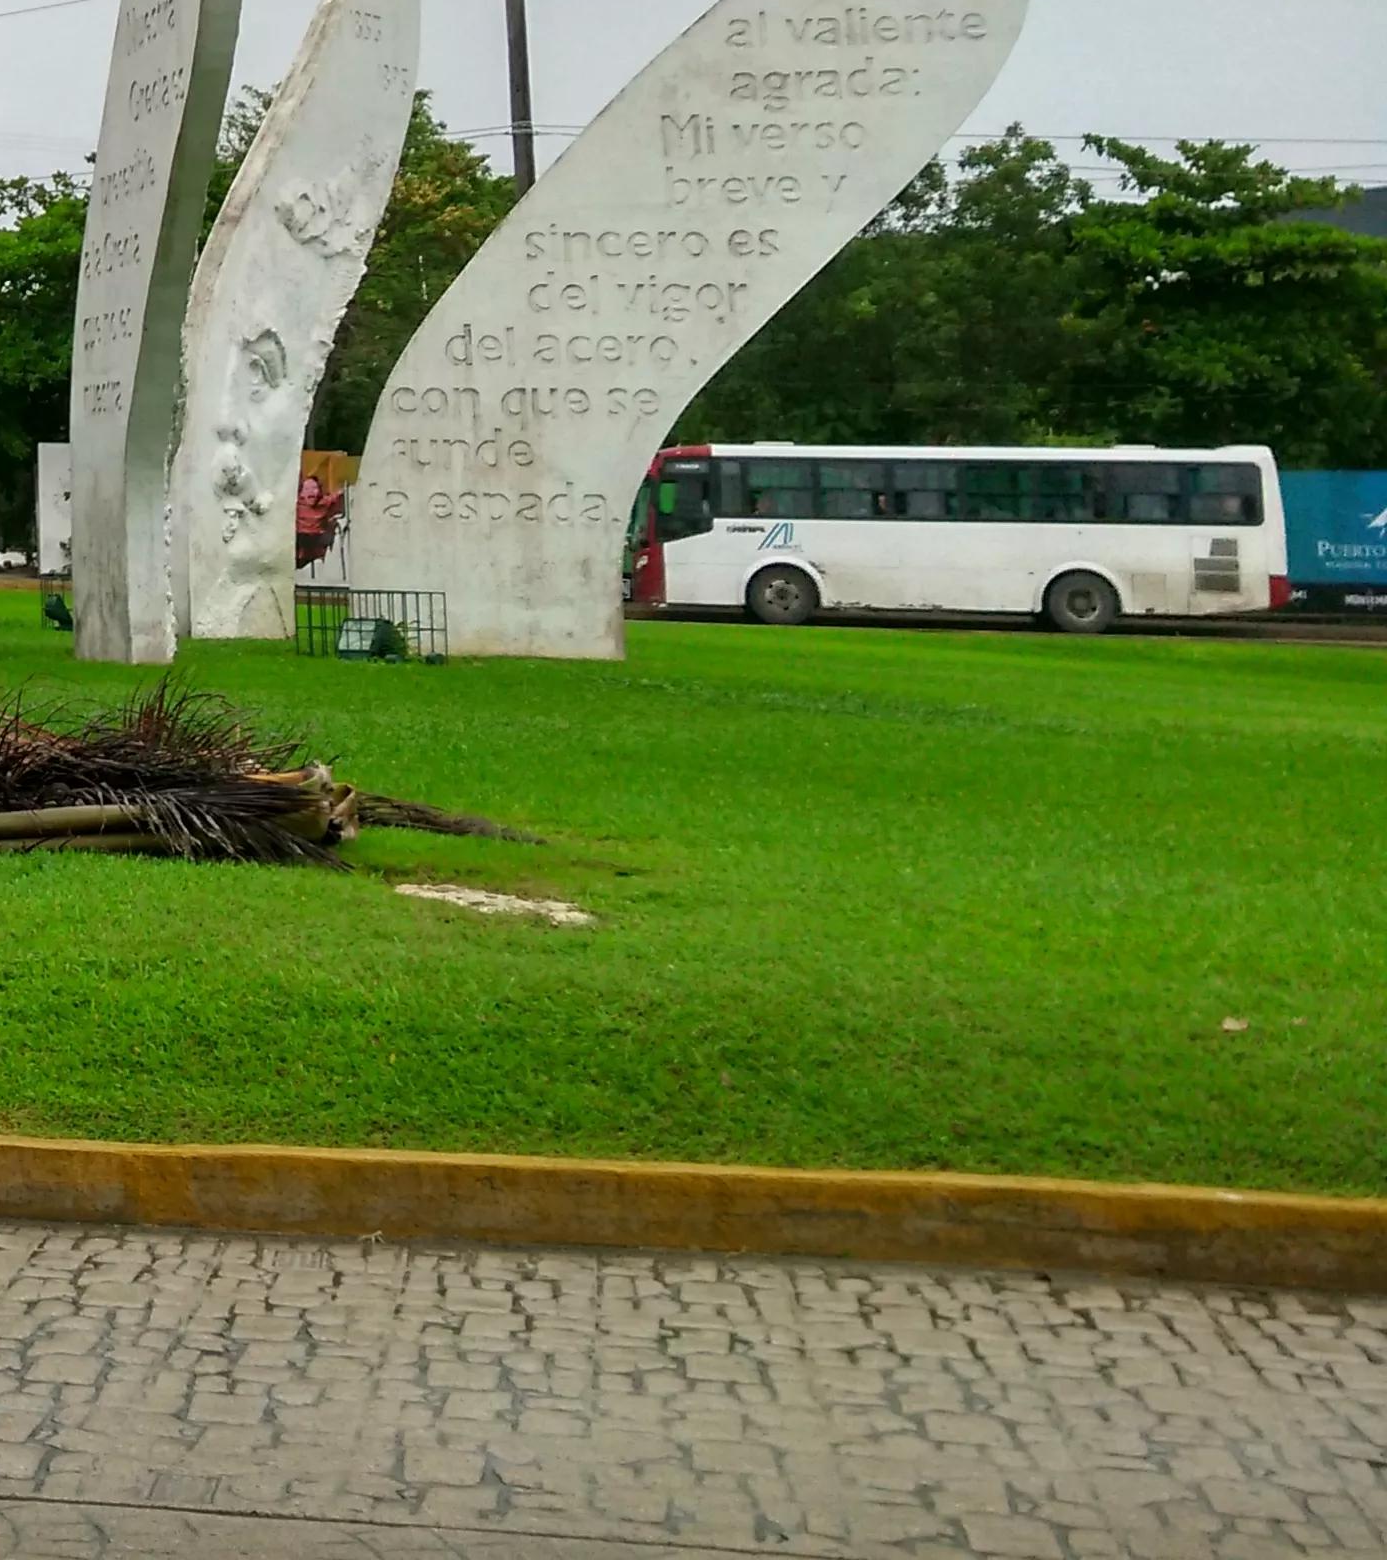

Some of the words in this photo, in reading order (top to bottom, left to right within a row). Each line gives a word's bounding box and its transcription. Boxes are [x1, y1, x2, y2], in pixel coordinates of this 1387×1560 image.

[726, 11, 767, 48] al
[785, 7, 987, 47] valiente
[729, 56, 921, 111] agrada:
[661, 113, 716, 157] Mi
[731, 121, 865, 150] verso
[665, 166, 801, 205] breve
[821, 175, 847, 213] y
[525, 223, 709, 263] sincero
[728, 229, 780, 257] es
[528, 271, 599, 315] del
[445, 323, 515, 366] del
[391, 387, 480, 420] con
[501, 387, 590, 430] que
[607, 388, 660, 416] se
[369, 482, 410, 520] la
